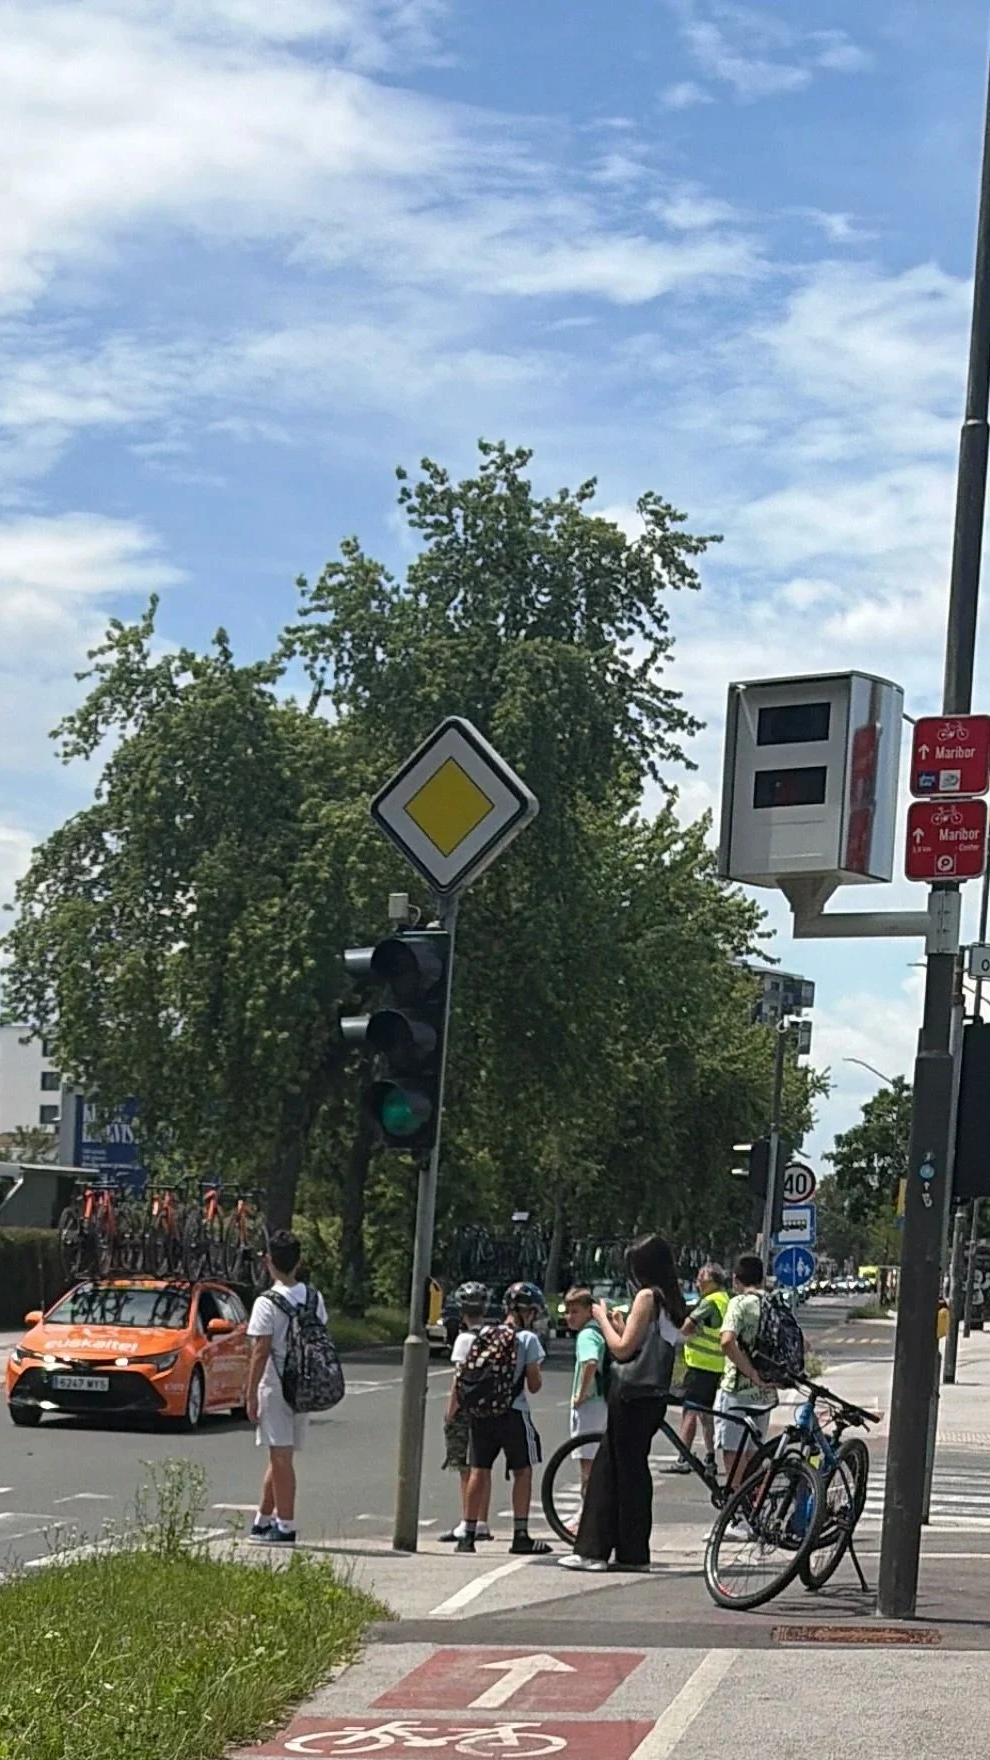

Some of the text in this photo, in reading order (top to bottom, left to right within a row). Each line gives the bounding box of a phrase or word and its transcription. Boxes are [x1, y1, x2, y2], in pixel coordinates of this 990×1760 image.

[935, 746, 976, 759] Maribor
[939, 828, 980, 841] Maribor
[784, 1174, 807, 1194] 40
[45, 1339, 139, 1353] euskaltel
